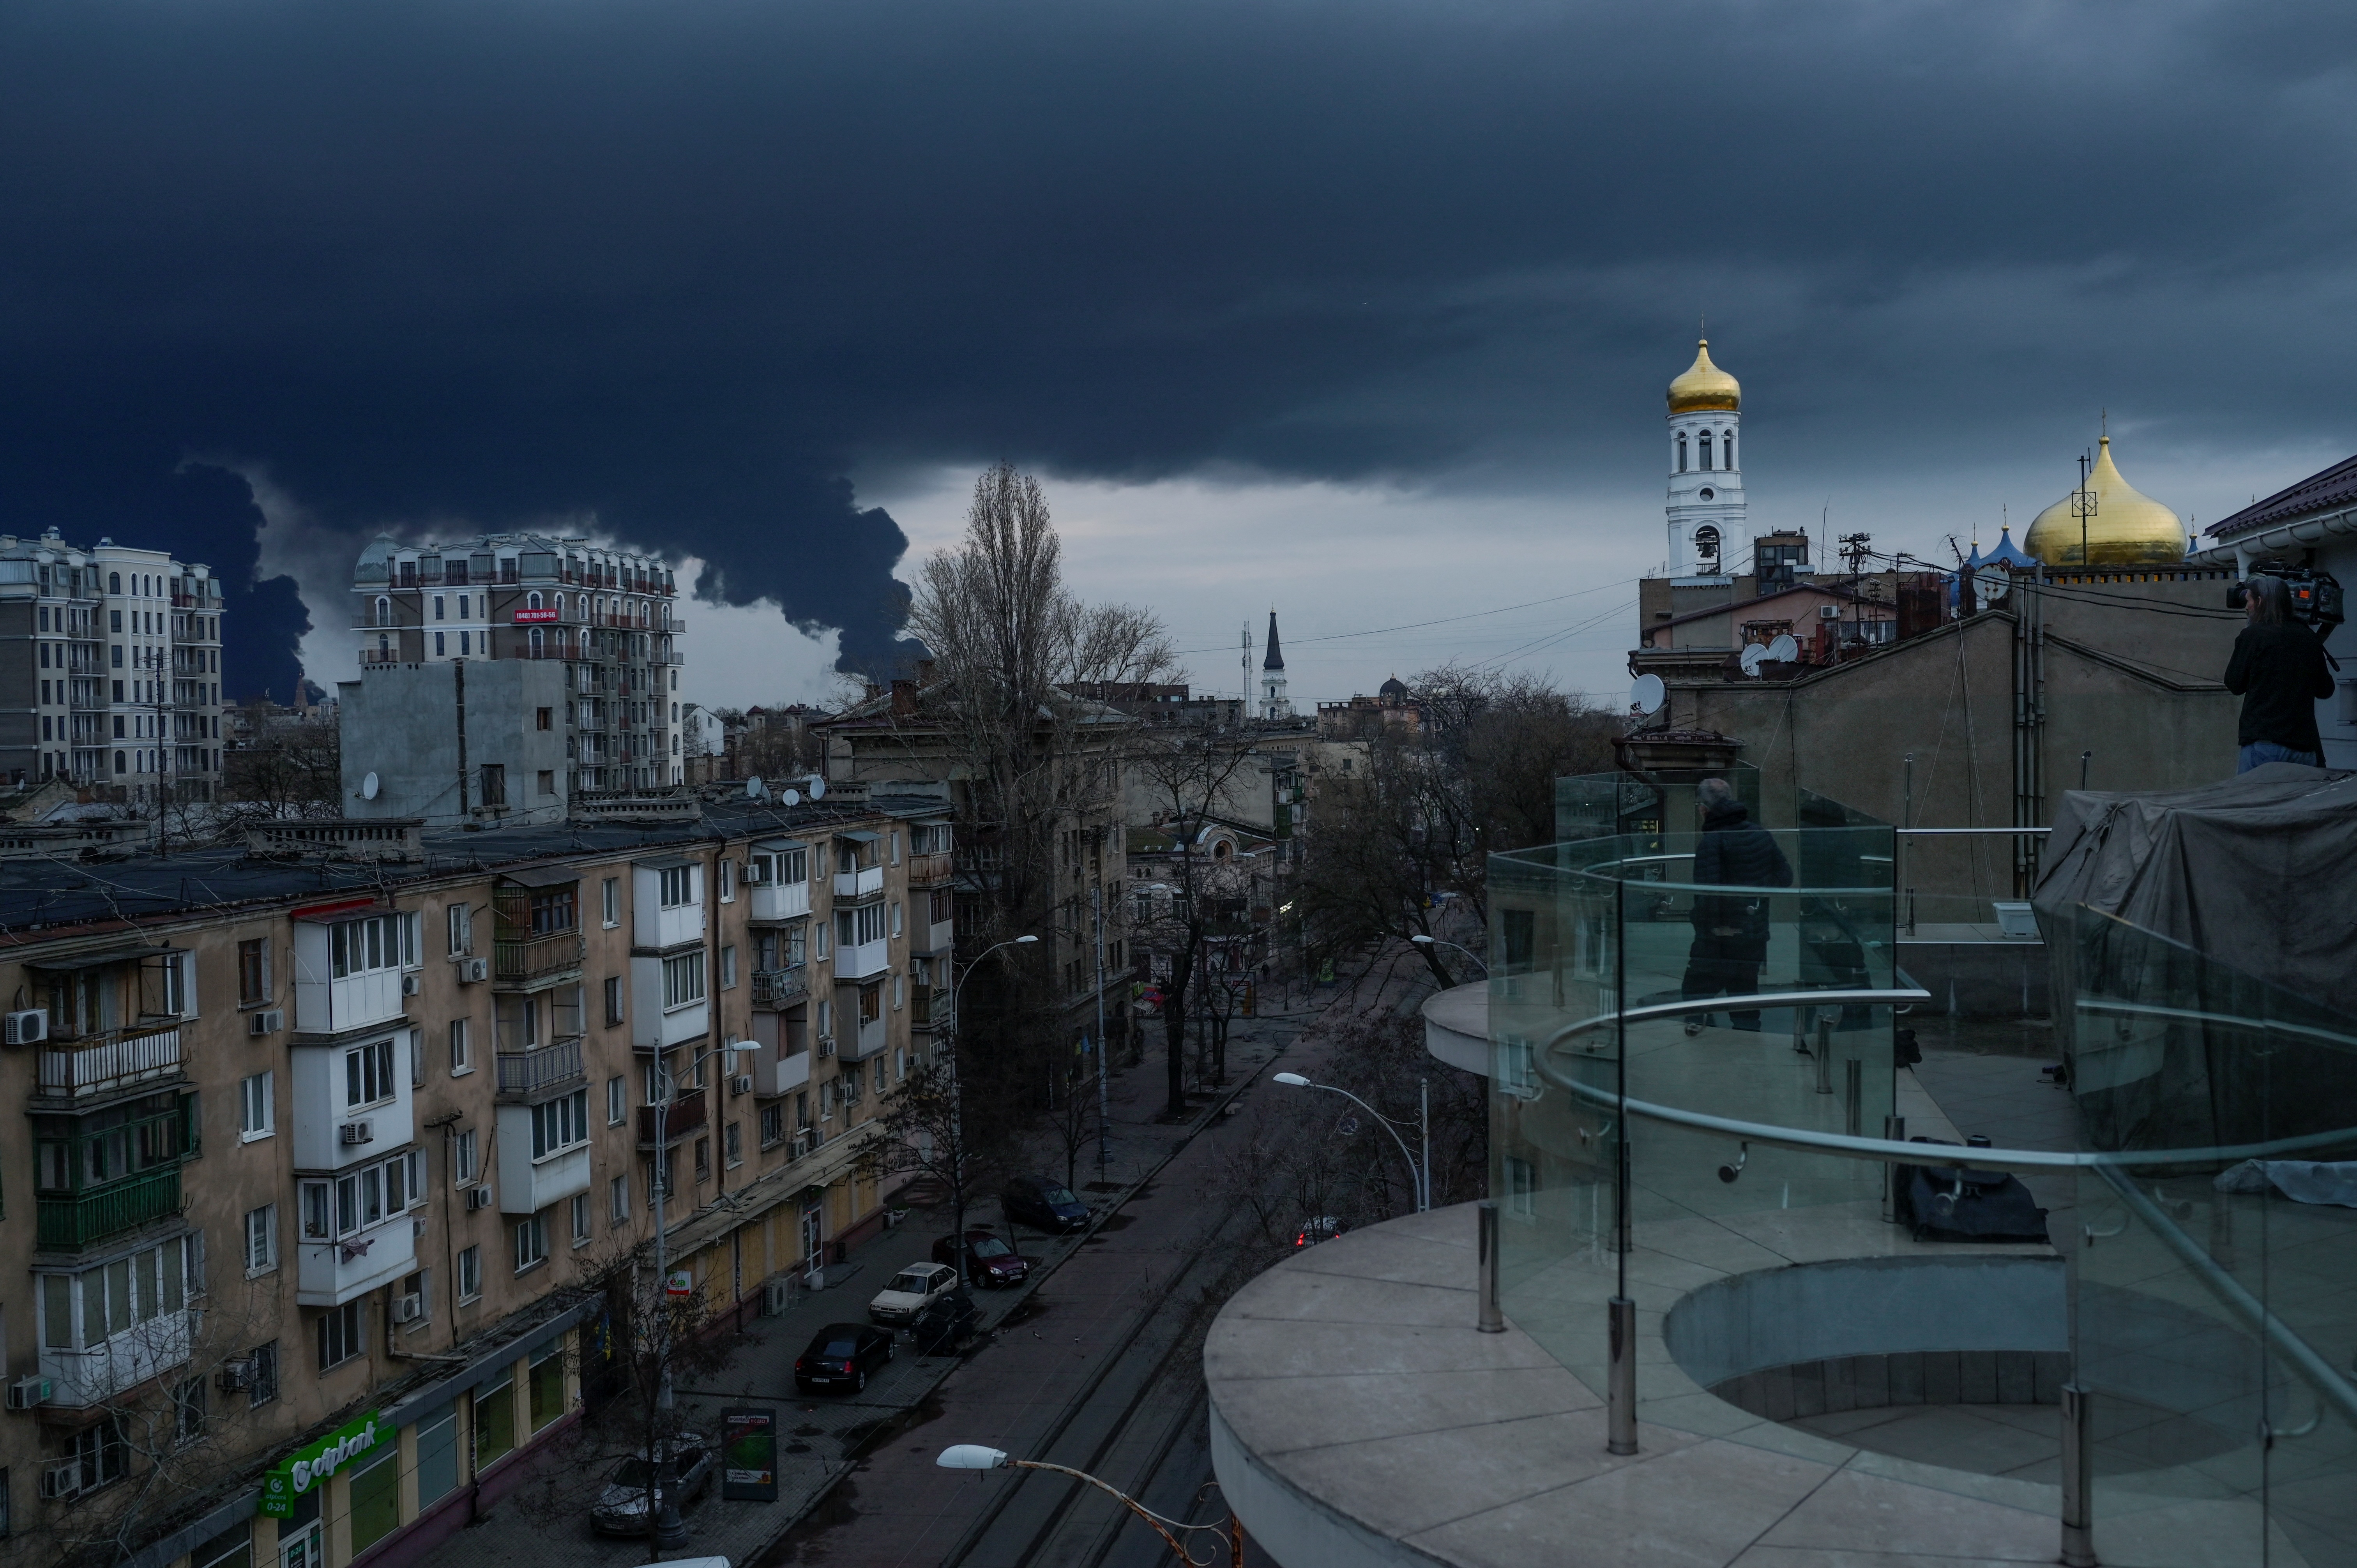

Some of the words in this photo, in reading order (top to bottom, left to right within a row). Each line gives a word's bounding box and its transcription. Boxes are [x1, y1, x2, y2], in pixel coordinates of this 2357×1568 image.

[311, 1421, 376, 1477] otpbank
[267, 1502, 286, 1512] 0-24
[290, 1544, 302, 1558] 0-24
